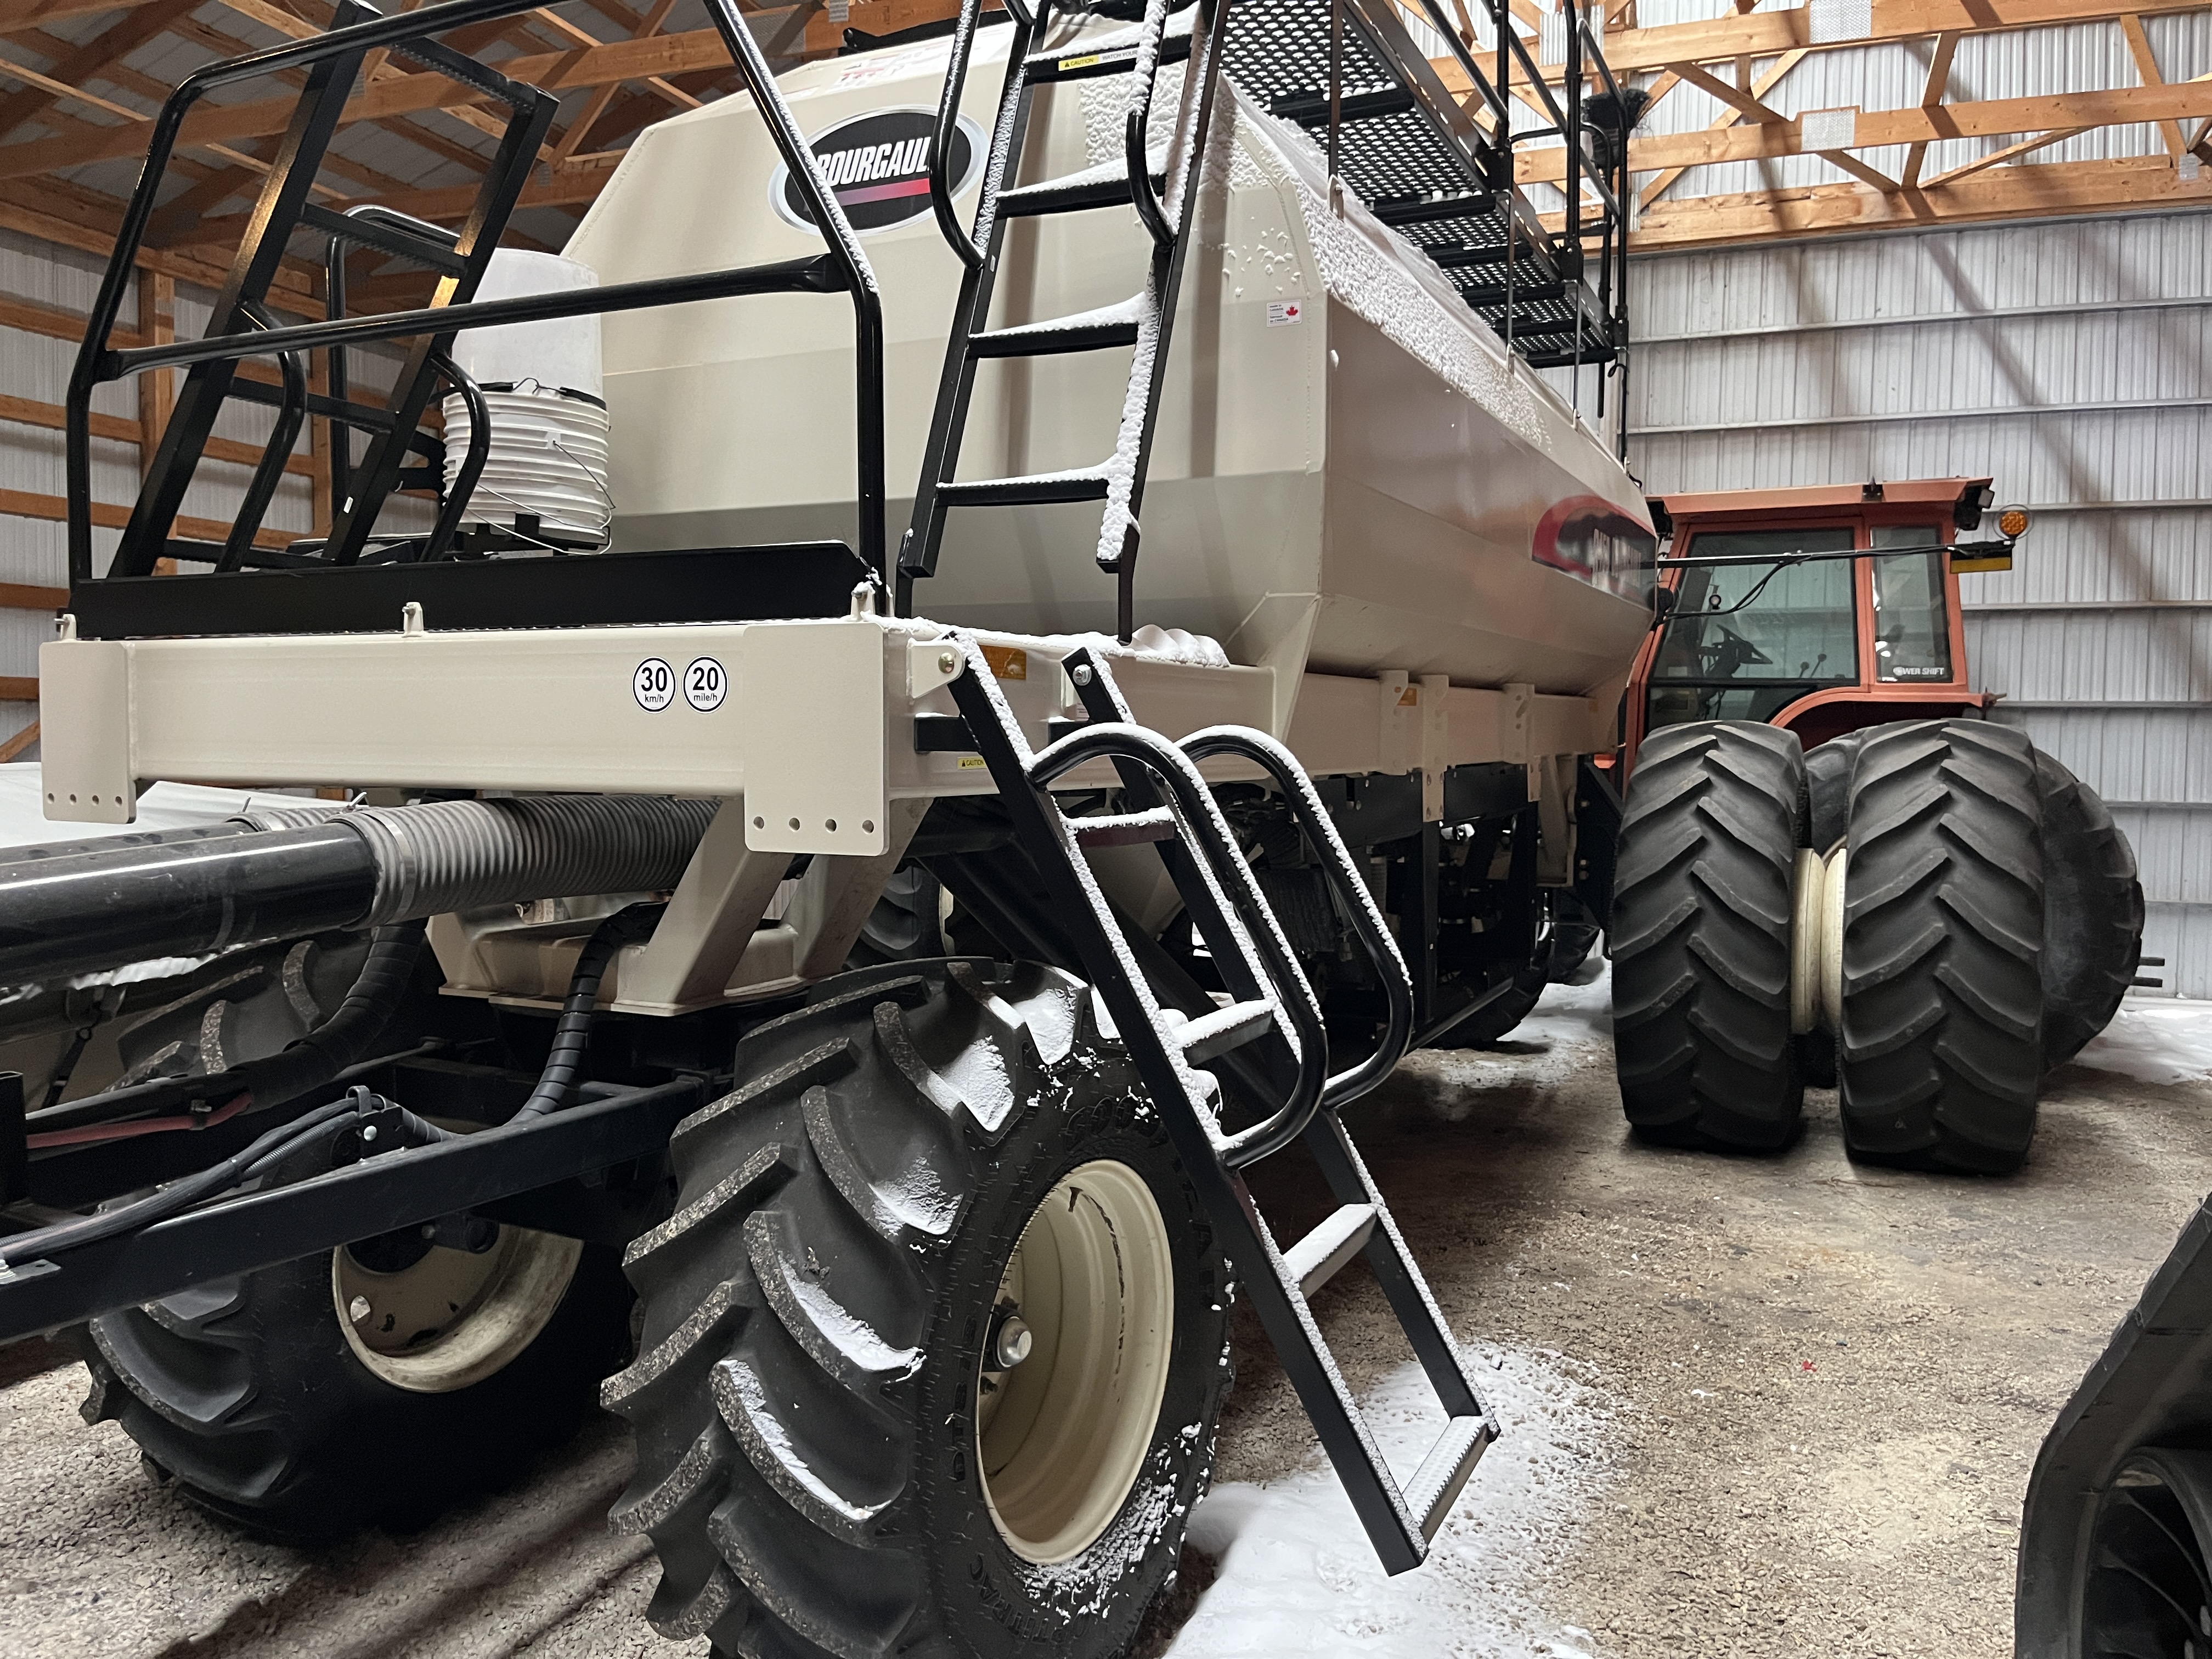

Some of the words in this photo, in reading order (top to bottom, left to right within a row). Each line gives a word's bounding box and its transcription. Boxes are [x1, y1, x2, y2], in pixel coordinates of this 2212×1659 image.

[1070, 58, 1094, 66] CAUTION
[816, 136, 932, 187] BOURGAUL
[1922, 667, 1944, 675] SHIFT
[641, 667, 667, 692] 30
[692, 667, 719, 691] 20
[645, 693, 664, 703] km/h
[693, 692, 718, 701] mile/h
